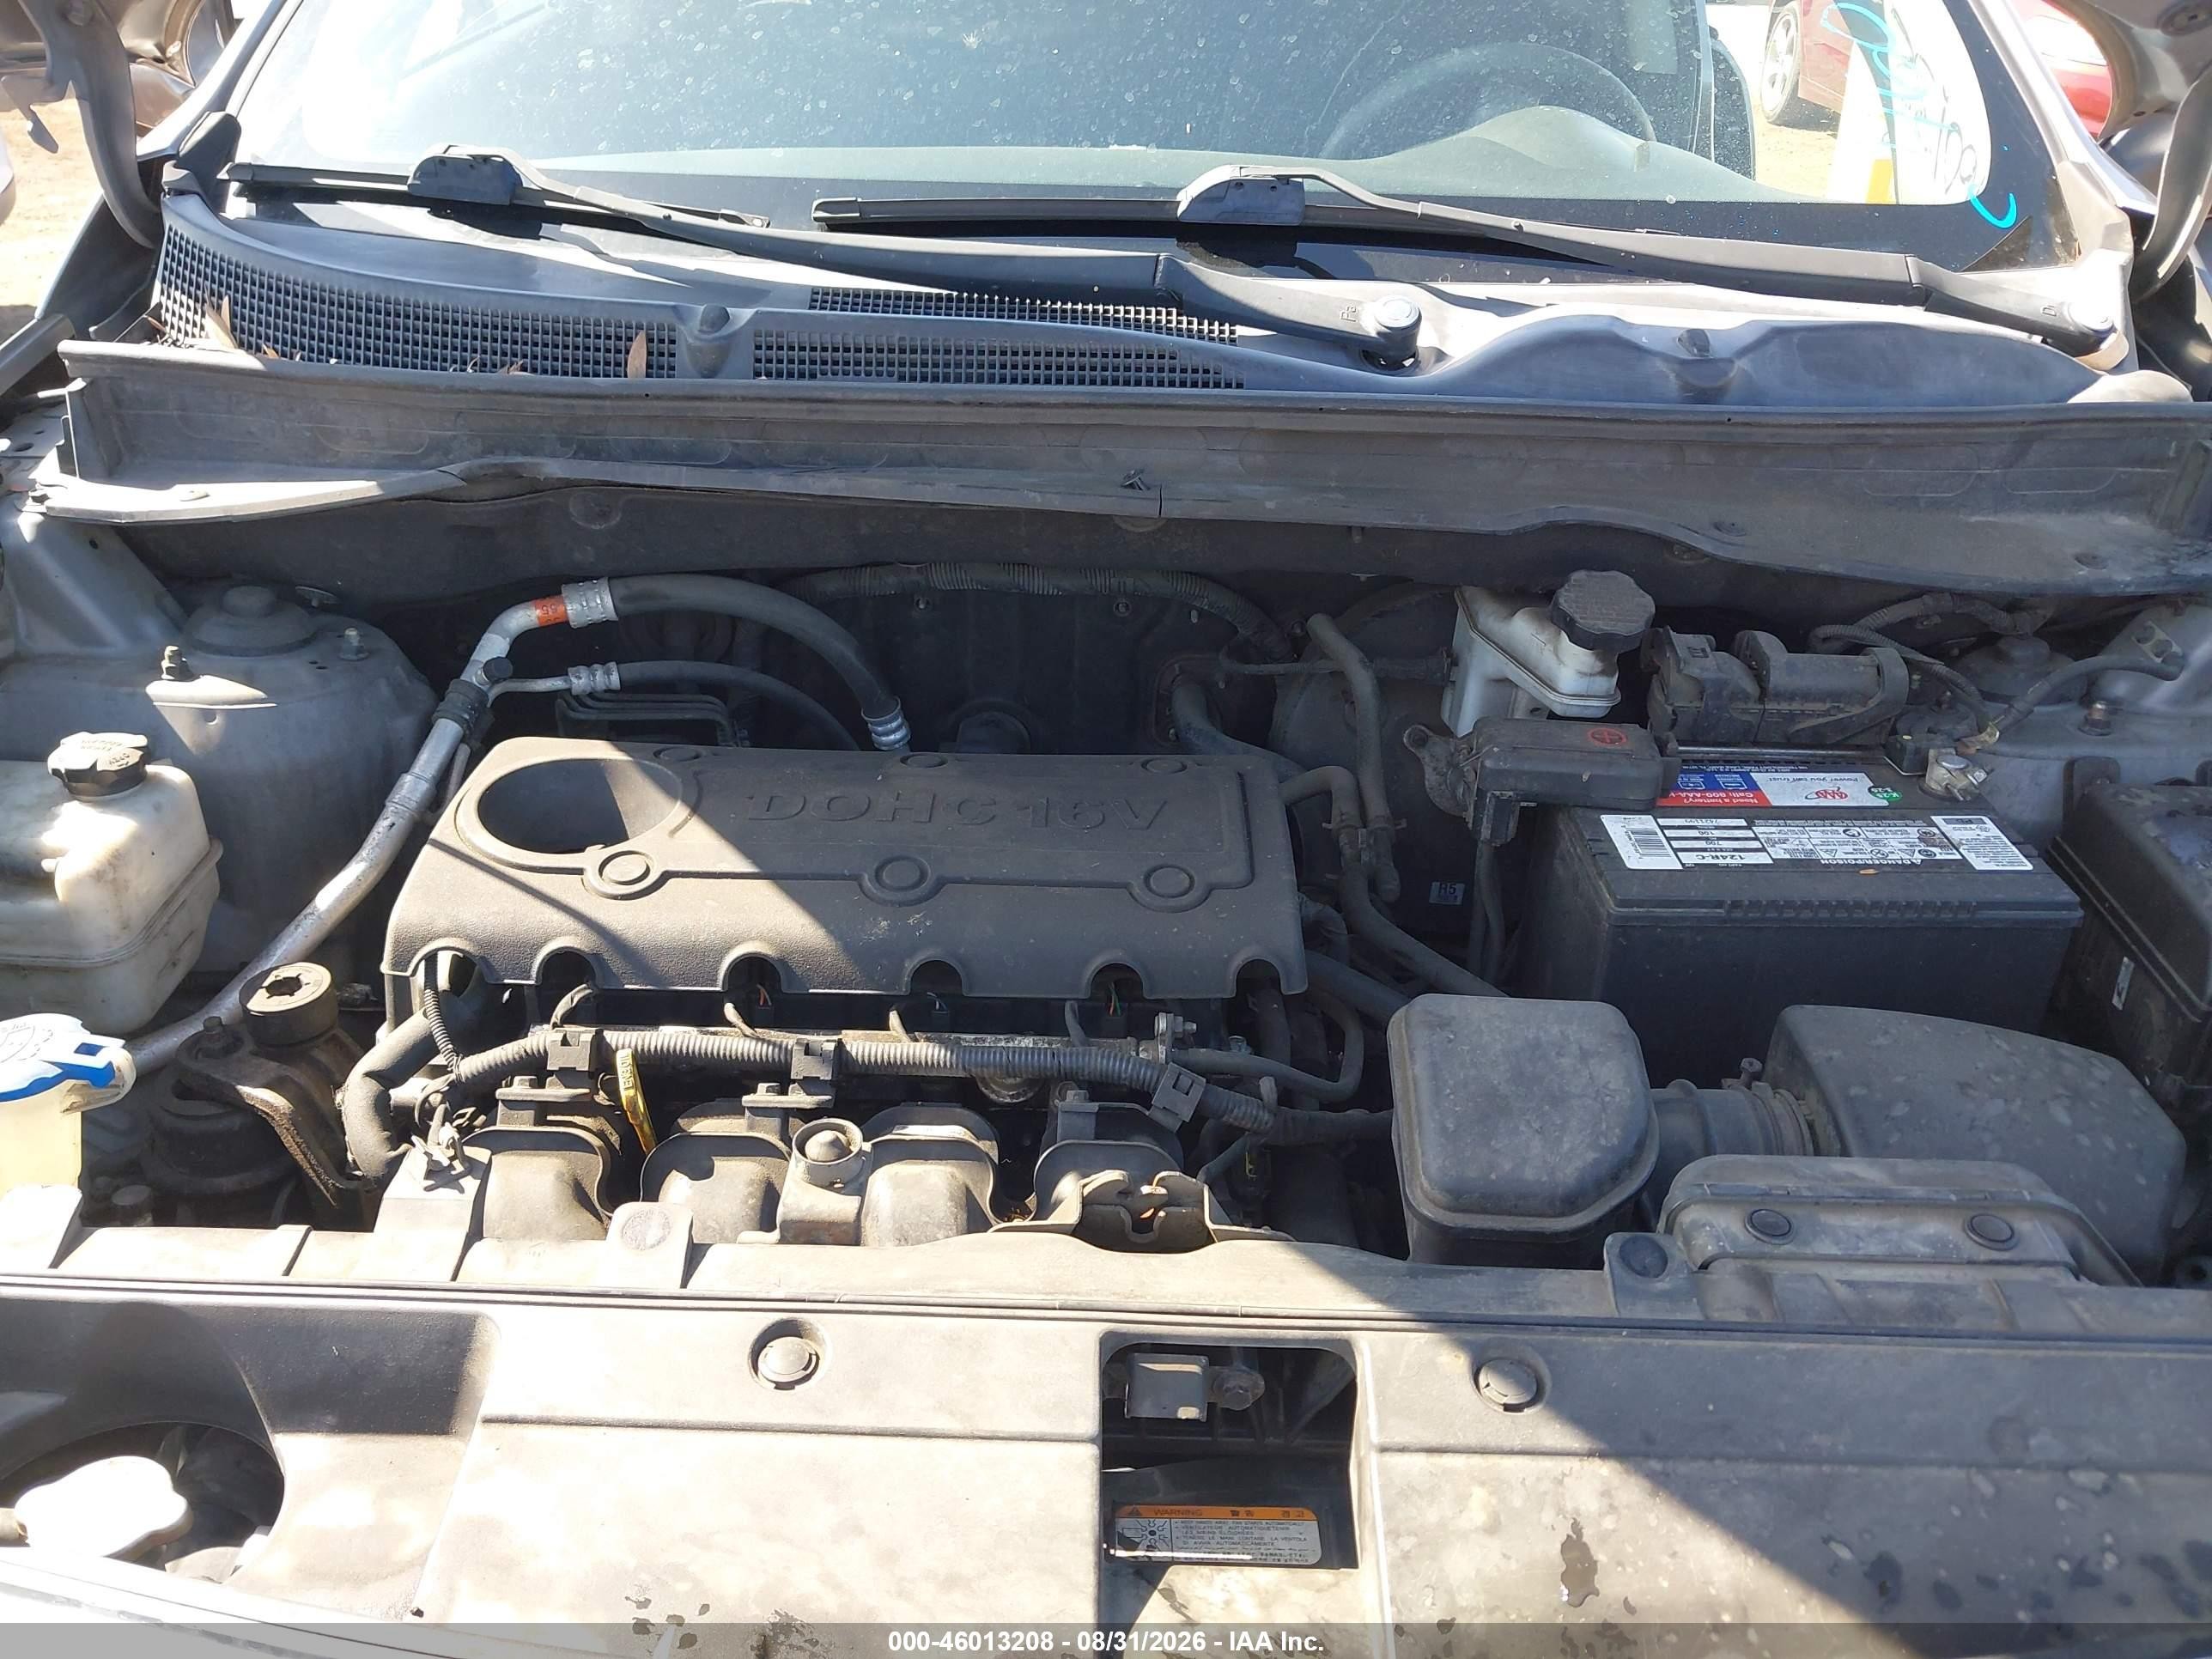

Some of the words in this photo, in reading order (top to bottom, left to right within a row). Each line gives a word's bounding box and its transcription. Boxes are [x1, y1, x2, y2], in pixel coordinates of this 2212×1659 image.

[1815, 789, 1846, 800] AAA
[744, 791, 998, 826] DOHC
[1016, 794, 1169, 831] 16V
